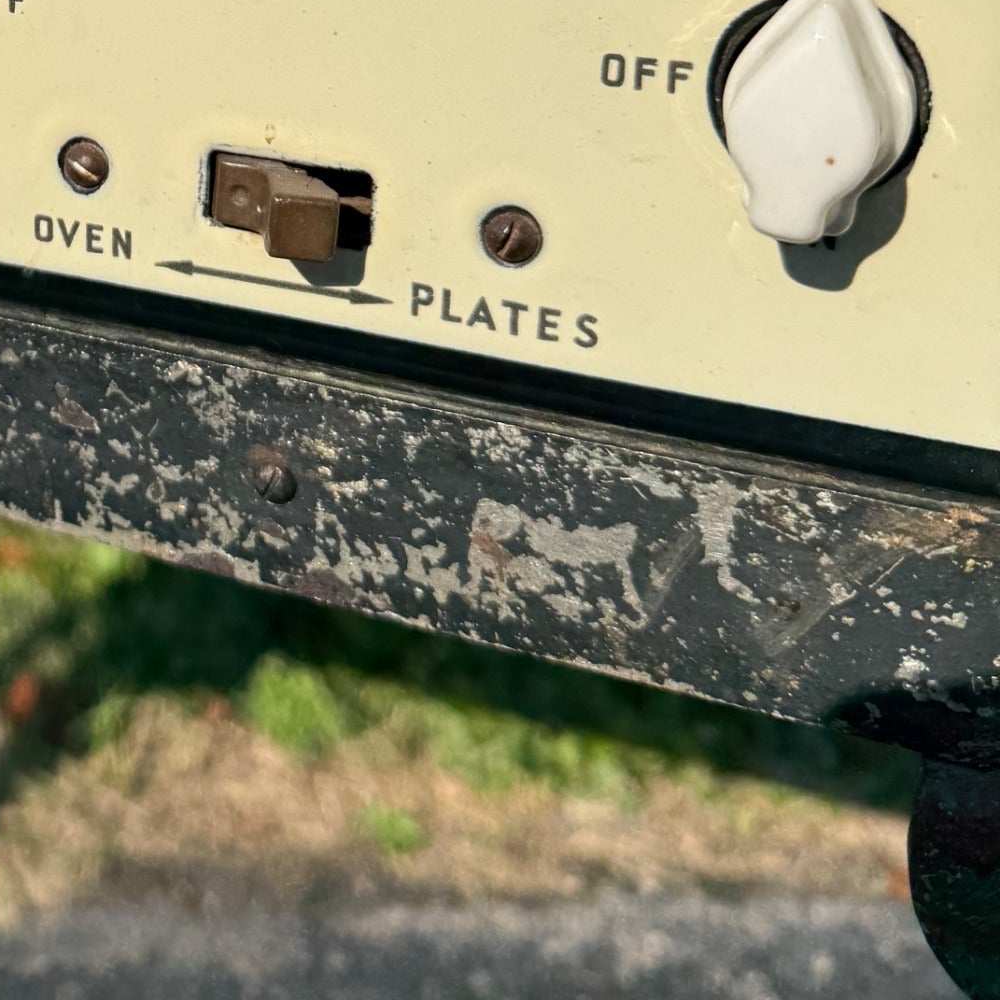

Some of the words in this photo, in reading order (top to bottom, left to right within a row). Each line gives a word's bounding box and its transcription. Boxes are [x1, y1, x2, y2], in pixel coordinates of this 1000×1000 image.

[600, 52, 694, 94] OFF
[33, 213, 133, 260] OVEN
[410, 281, 599, 349] PLATES
